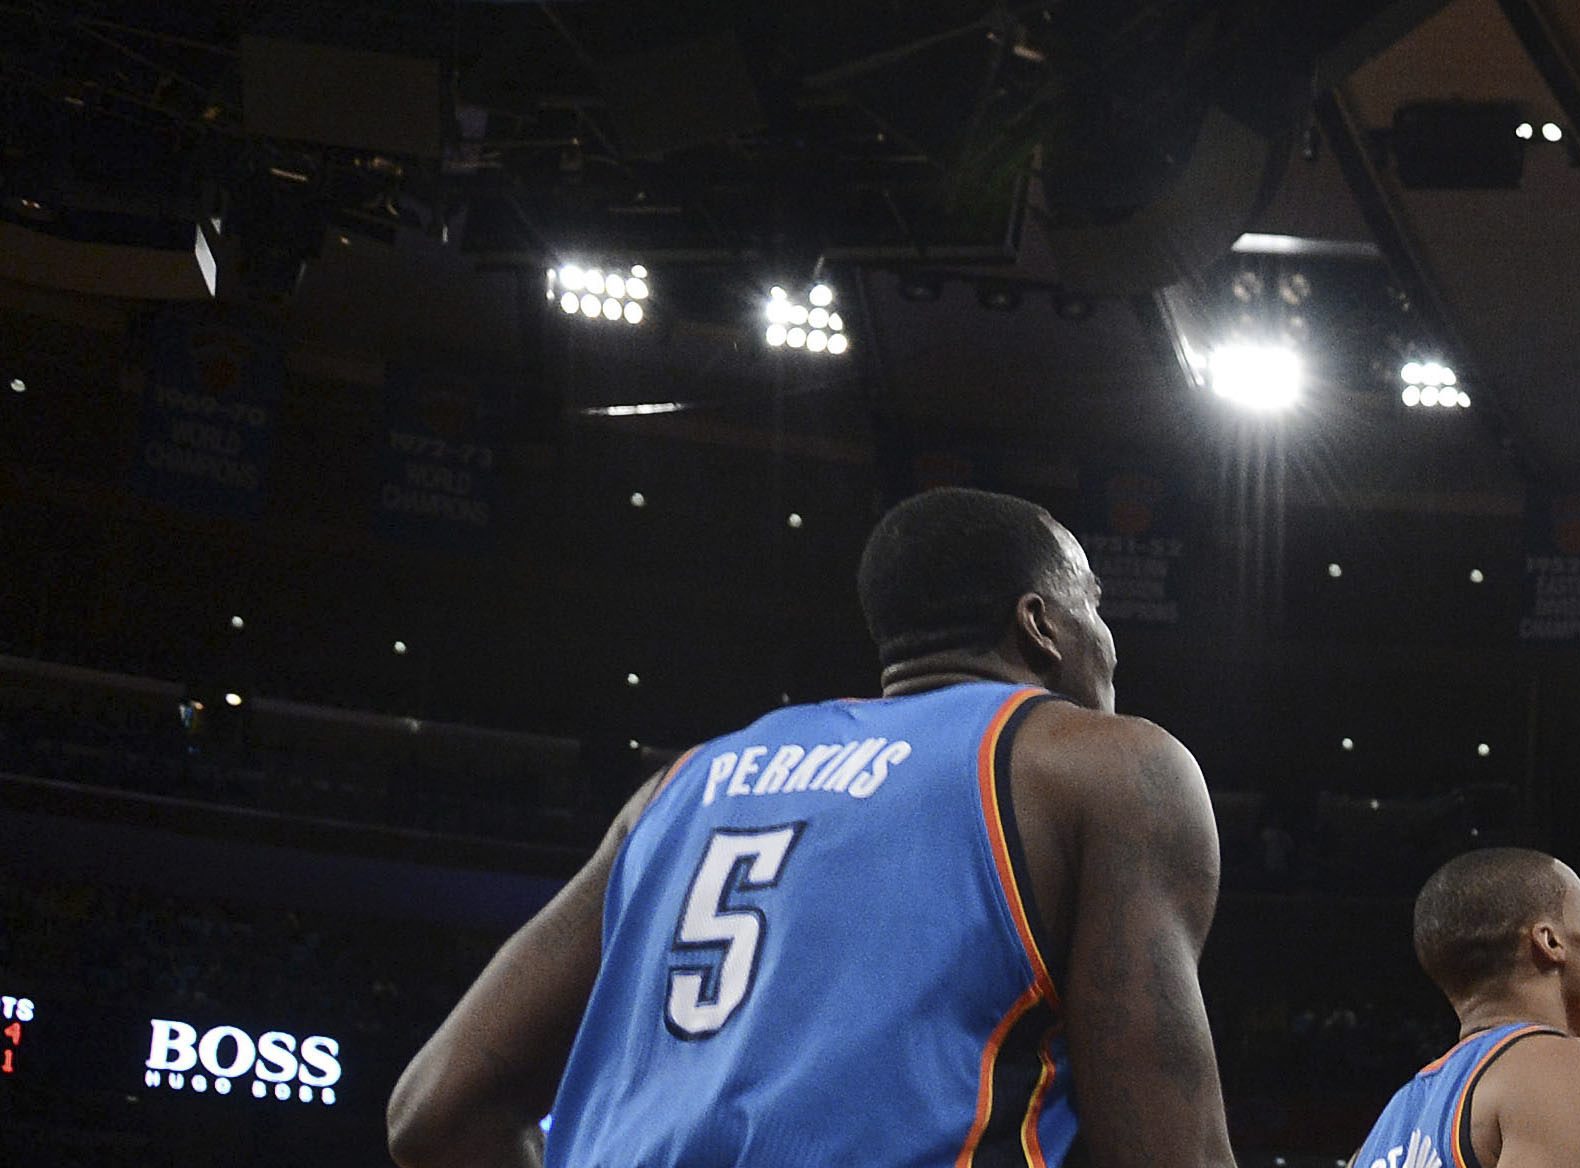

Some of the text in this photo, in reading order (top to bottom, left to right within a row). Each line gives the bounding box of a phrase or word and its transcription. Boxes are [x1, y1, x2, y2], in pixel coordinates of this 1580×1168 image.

[702, 737, 912, 807] PERKINS
[663, 820, 807, 1042] 5
[145, 1018, 342, 1088] BOSS
